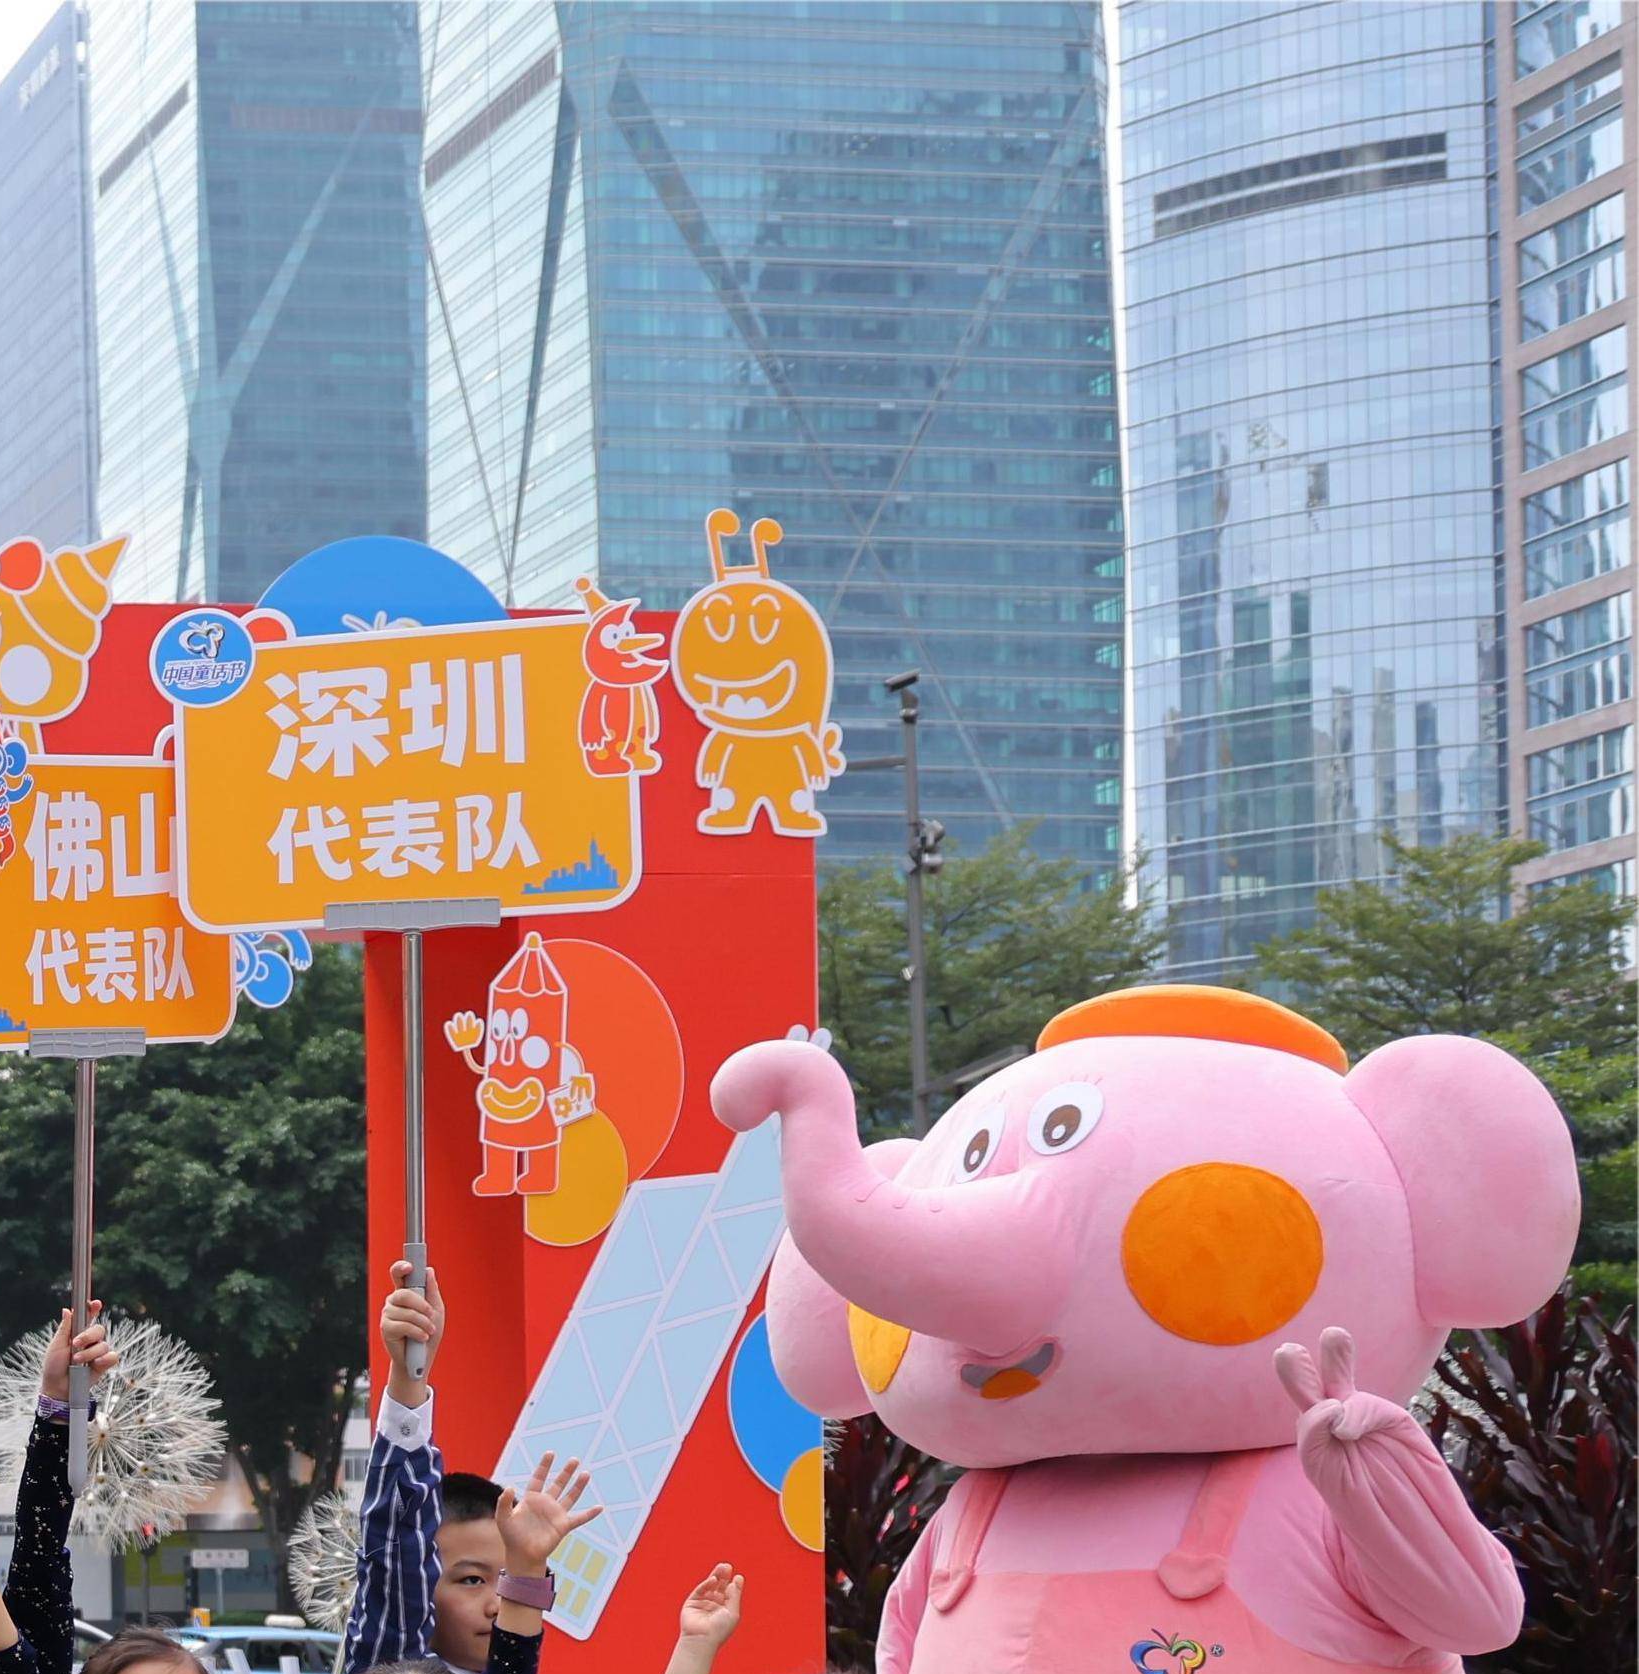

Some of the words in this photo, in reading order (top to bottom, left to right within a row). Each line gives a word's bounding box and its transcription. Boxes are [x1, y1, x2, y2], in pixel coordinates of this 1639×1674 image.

[164, 662, 244, 684] 中国童话节
[264, 653, 526, 780] 深圳
[24, 791, 179, 902] 佛山
[266, 792, 540, 884] 代表队
[24, 927, 195, 1005] 代表队
